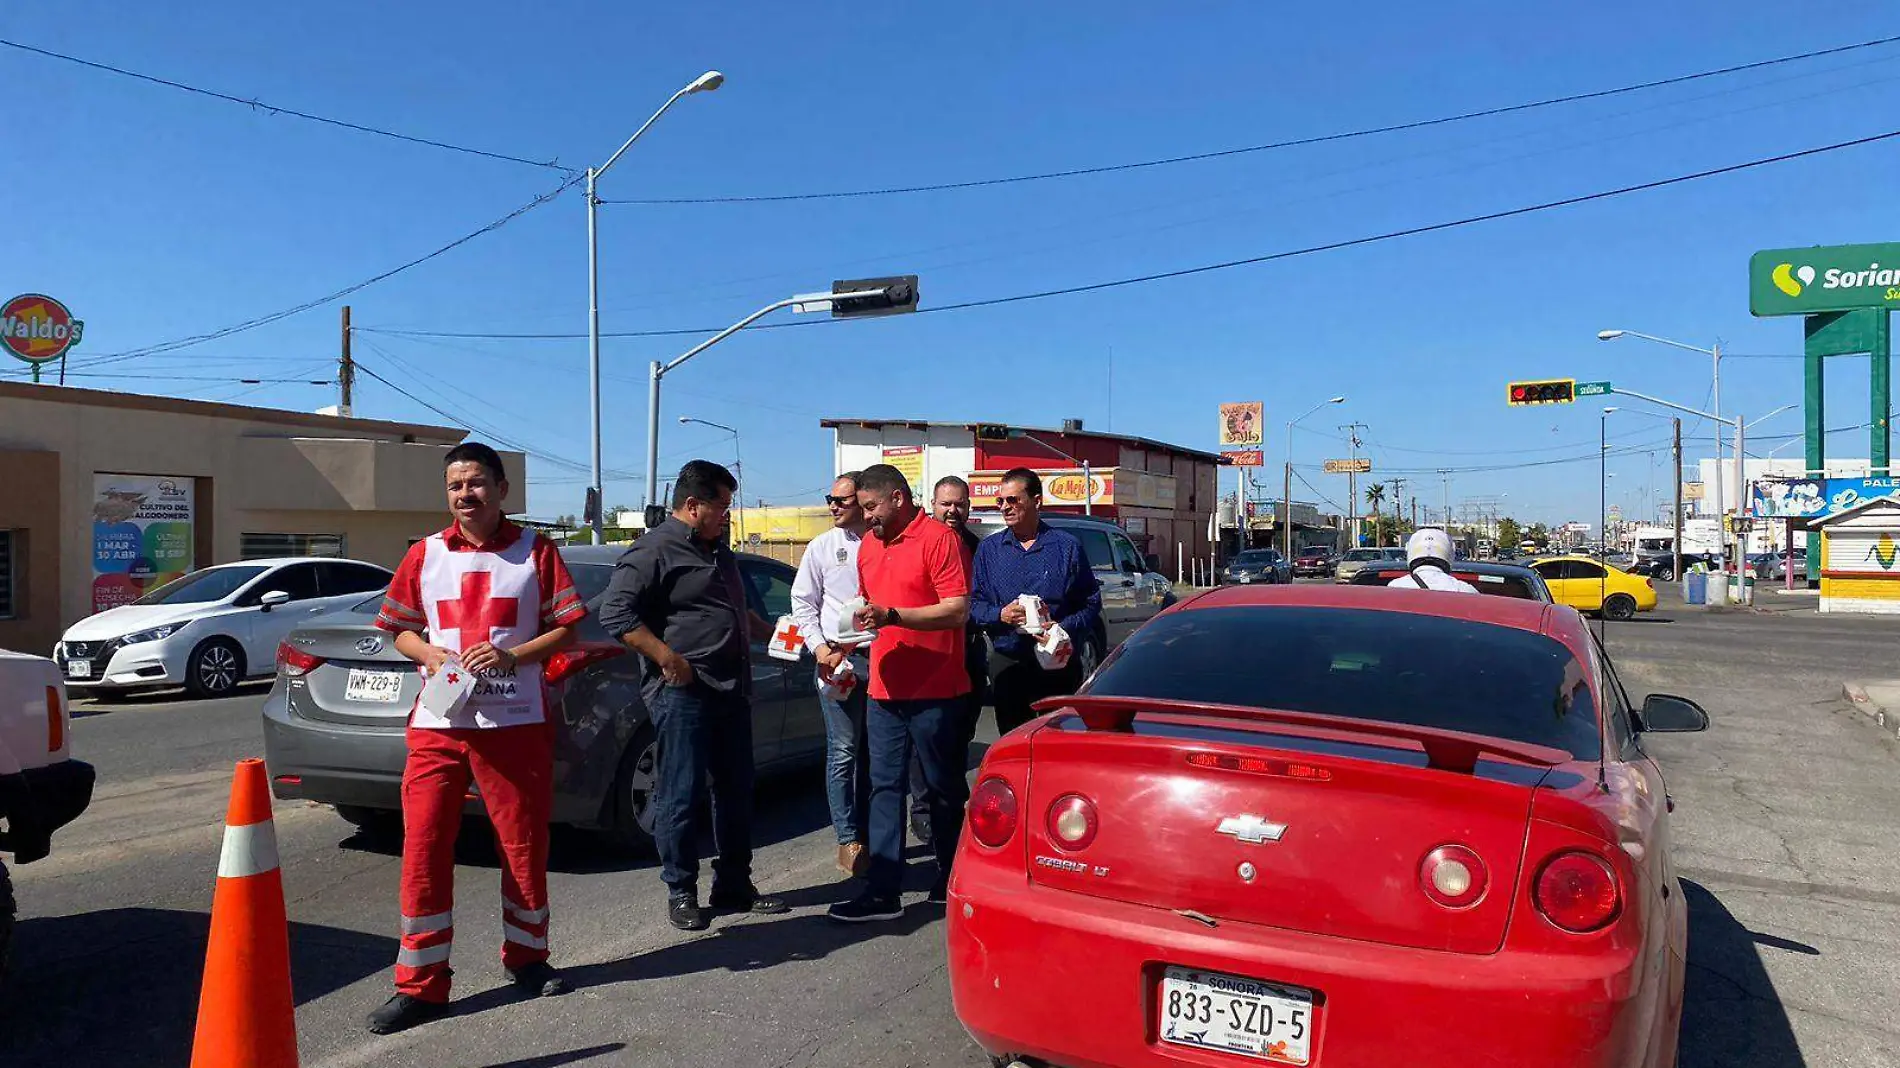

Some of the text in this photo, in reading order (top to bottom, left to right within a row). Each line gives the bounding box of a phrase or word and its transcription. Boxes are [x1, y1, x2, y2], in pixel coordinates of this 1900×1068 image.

[974, 484, 1002, 496] EMP
[104, 541, 129, 550] MAR
[113, 550, 136, 560] ABR
[1035, 855, 1110, 877] COBALT LT
[1208, 977, 1264, 996] SONORA
[1168, 989, 1305, 1040] 833-SZD-5
